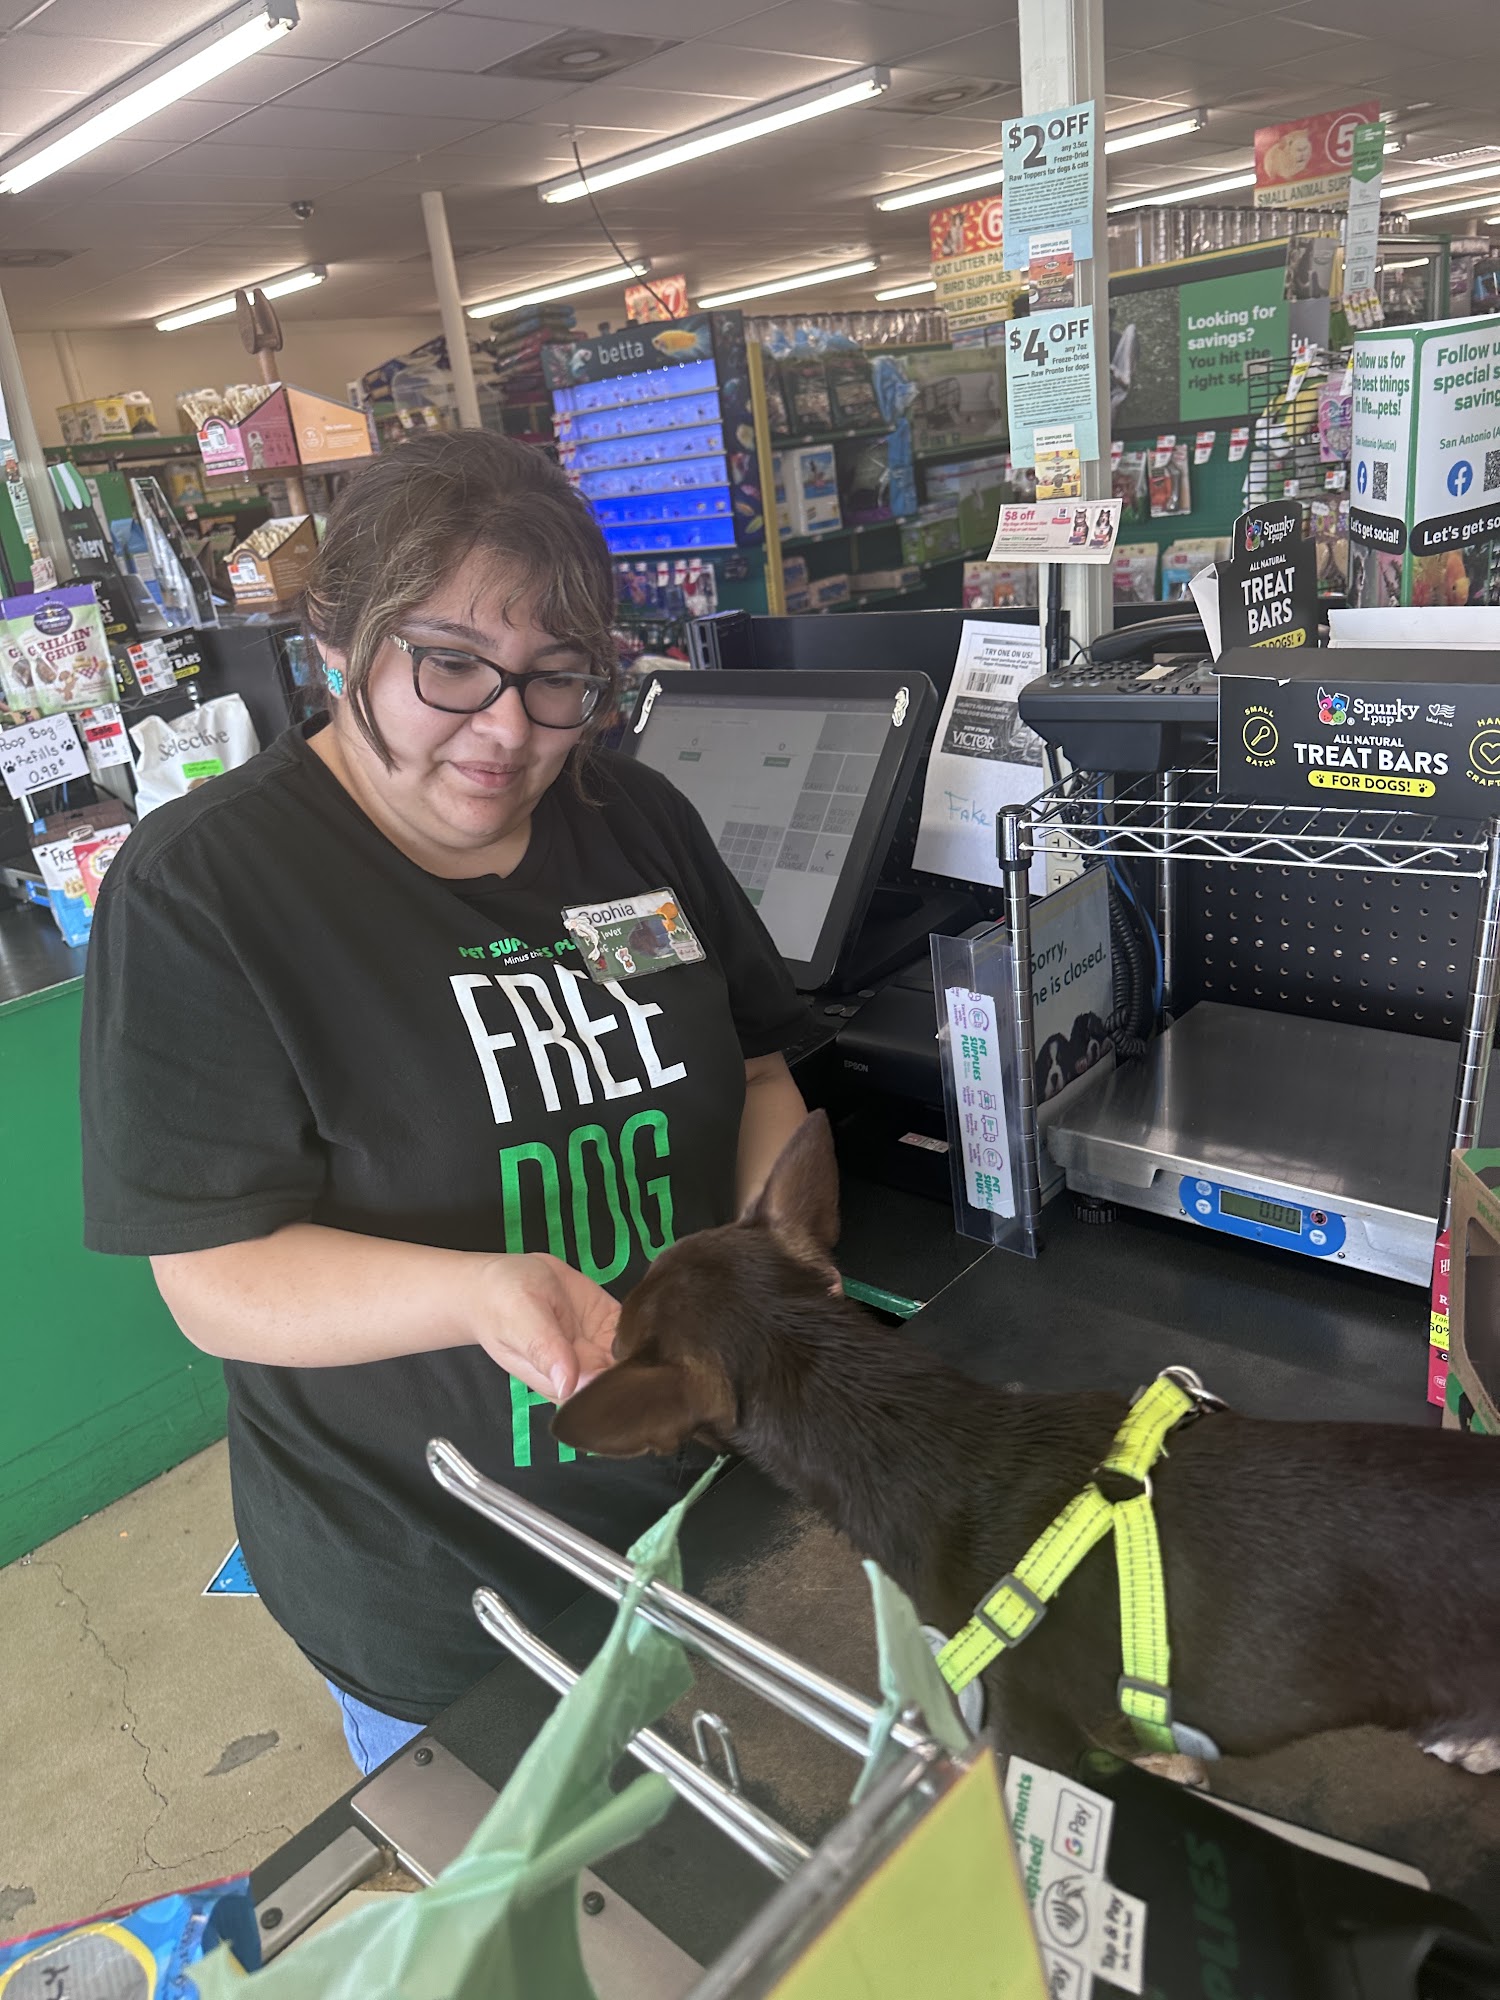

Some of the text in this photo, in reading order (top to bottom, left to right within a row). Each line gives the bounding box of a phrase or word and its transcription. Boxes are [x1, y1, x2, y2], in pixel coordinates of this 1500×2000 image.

[1048, 112, 1089, 140] OFF
[1061, 144, 1072, 152] any
[1336, 122, 1358, 157] 5
[1053, 150, 1089, 164] Freeze-Dried
[1009, 174, 1022, 182] Raw
[1023, 170, 1047, 180] Toppers
[1047, 167, 1056, 175] for
[1057, 165, 1071, 174] dogs
[1077, 161, 1089, 169] cats
[1257, 183, 1325, 206] SMALL ANIMAL
[988, 207, 1003, 238] 6
[935, 256, 986, 277] CAT LITTER
[943, 271, 1012, 293] BIRD SUPPLIES
[966, 294, 988, 307] BIRD
[1187, 305, 1277, 330] Looking for
[1049, 319, 1089, 342] OFF
[1187, 328, 1255, 350] savings?
[598, 341, 645, 364] betta
[1052, 352, 1089, 364] Freeze-Dried
[1189, 347, 1271, 369] You hit the
[1356, 351, 1405, 369] Follow us for
[1437, 343, 1490, 367] Follow
[1045, 367, 1064, 375] Pronto
[1075, 363, 1089, 372] dogs
[1433, 364, 1490, 394] special
[1188, 372, 1225, 391] right
[1362, 375, 1410, 396] best things
[1355, 397, 1361, 413] in
[1377, 439, 1397, 452] (Austin)
[1440, 429, 1491, 449] San Antonio
[1005, 510, 1035, 521] $8 off
[1263, 515, 1296, 541] Spunky
[1272, 534, 1284, 543] pup
[1362, 524, 1374, 539] get
[1374, 527, 1399, 544] social!
[1423, 519, 1485, 546] Let's get
[1250, 554, 1287, 572] ALL NATURAL
[1241, 567, 1295, 606] TREAT
[1248, 598, 1293, 635] BARS
[46, 641, 87, 663] GRUB
[985, 648, 1033, 659] TRY ONE ON US!
[1244, 705, 1275, 718] SMALL
[1353, 698, 1420, 722] Spunky
[91, 726, 113, 737] Sale
[1371, 715, 1394, 727] pup
[0, 727, 57, 753] Poop Bag
[159, 729, 231, 762] Selective
[952, 731, 995, 750] VICTOR
[1333, 734, 1404, 748] ALL NATURAL
[16, 745, 60, 764] Refills
[1245, 756, 1276, 768] BATCH
[1293, 743, 1449, 776] TREAT BARS
[1332, 775, 1411, 792] FOR DOGS!
[578, 903, 636, 927] Sophia
[601, 927, 622, 942] lover
[458, 945, 486, 960] PET
[504, 954, 530, 967] Minus
[1031, 940, 1069, 975] Sorry,
[1050, 947, 1107, 998] is closed.
[449, 963, 688, 1124] FREE
[961, 1034, 971, 1059] PLUS
[978, 1037, 988, 1057] PET
[844, 1060, 869, 1072] EPSON
[970, 1035, 982, 1081] SUPPLIES
[974, 1171, 985, 1195] PLUS
[991, 1176, 1001, 1194] PET
[498, 1110, 675, 1286] DOG
[1259, 1201, 1297, 1225] 0.00
[1068, 1803, 1092, 1837] Pay
[1101, 1893, 1124, 1970] Tap & Pay
